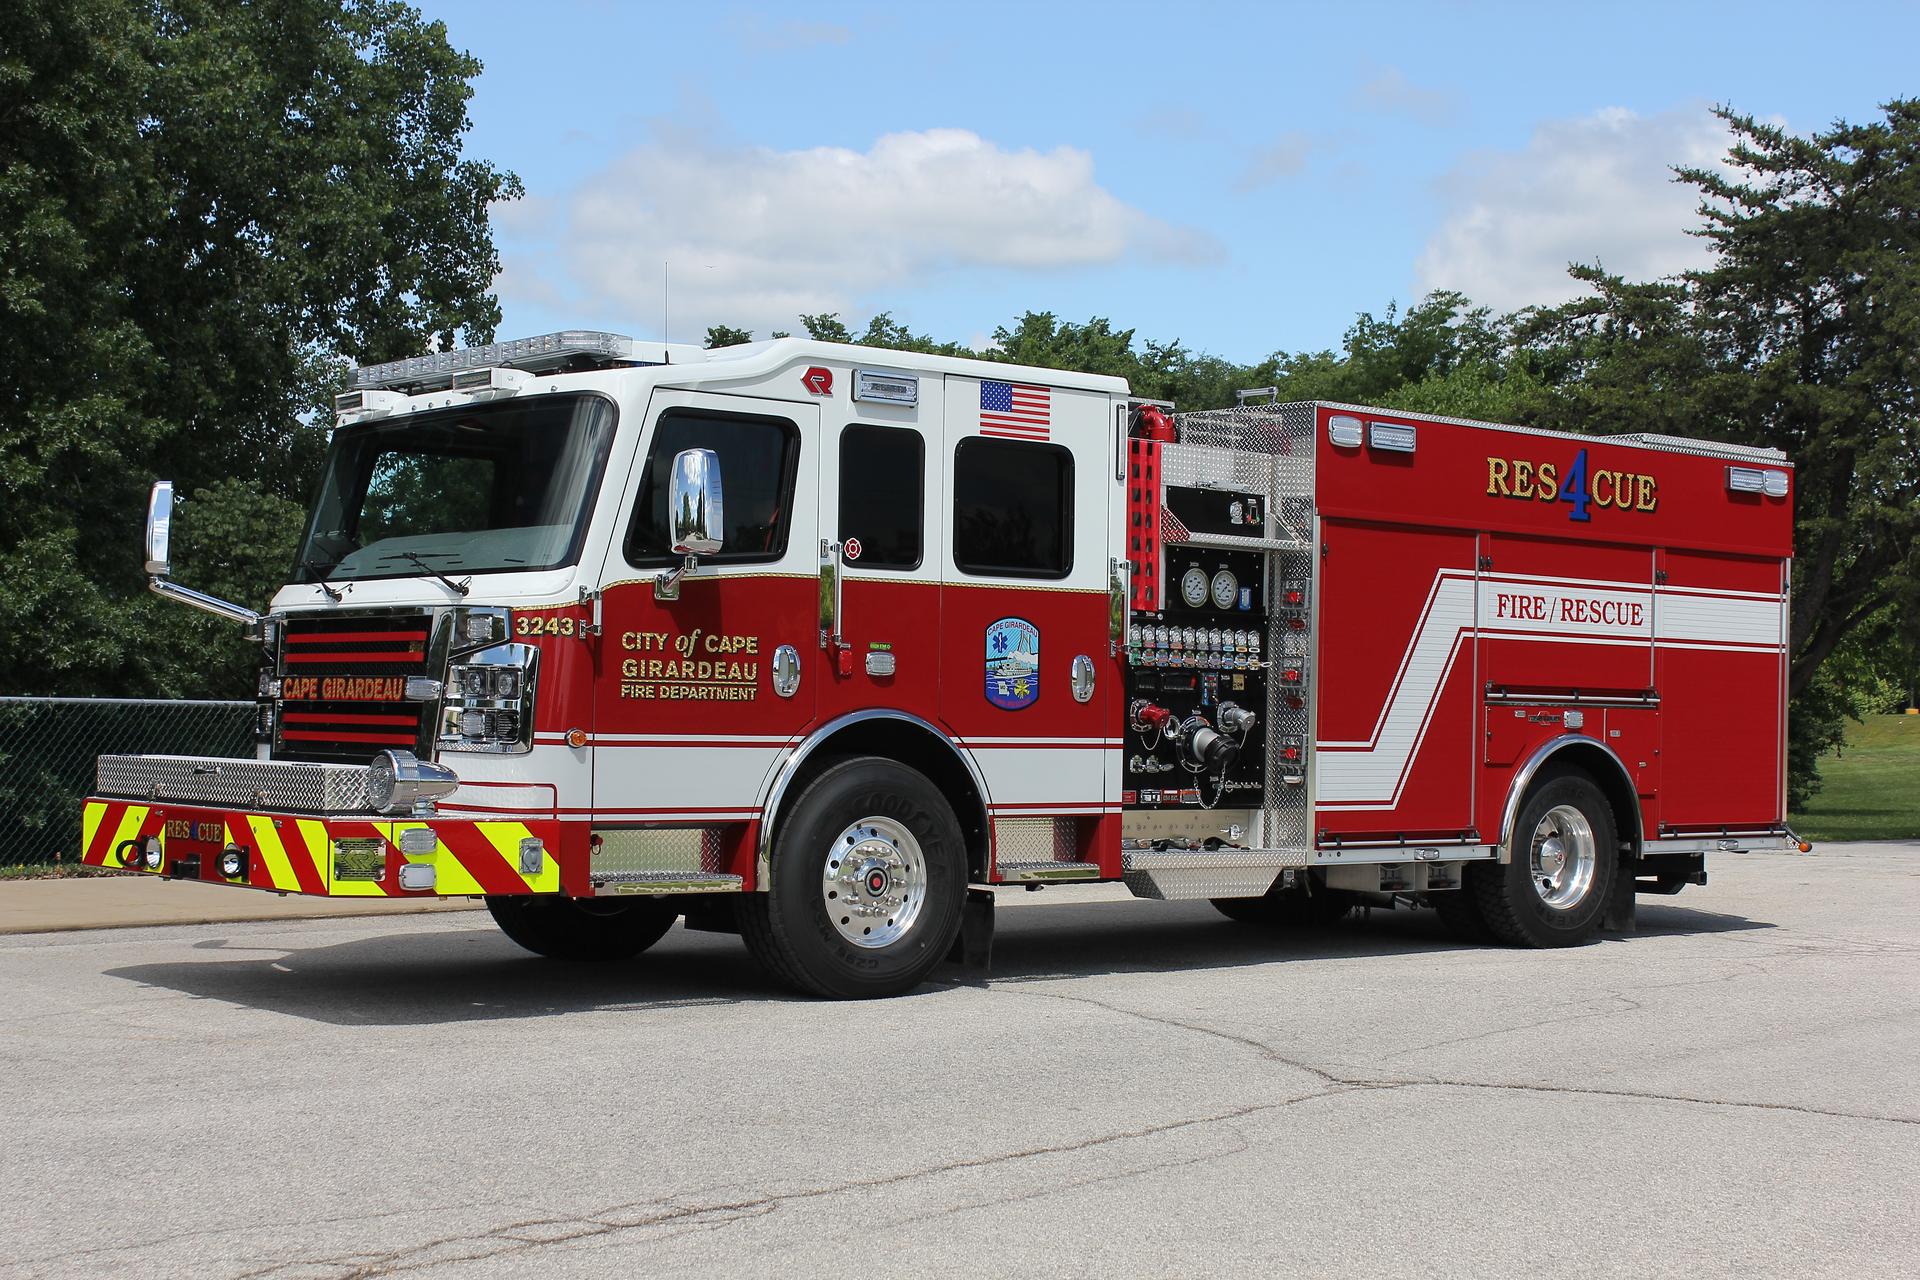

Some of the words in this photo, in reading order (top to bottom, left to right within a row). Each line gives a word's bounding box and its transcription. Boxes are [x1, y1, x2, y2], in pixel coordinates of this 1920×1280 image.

[515, 616, 575, 636] 3243
[988, 622, 1004, 636] CAPE
[1004, 621, 1038, 638] GIRARDEAU
[621, 631, 670, 651] CITY
[674, 628, 702, 658] of
[705, 634, 759, 654] CAPE
[621, 658, 758, 681] GIRARDEAU
[282, 677, 318, 700] CAPE
[321, 677, 403, 701] GIRARDEAU
[621, 684, 656, 699] FIRE
[659, 685, 758, 701] DEPARTMENT
